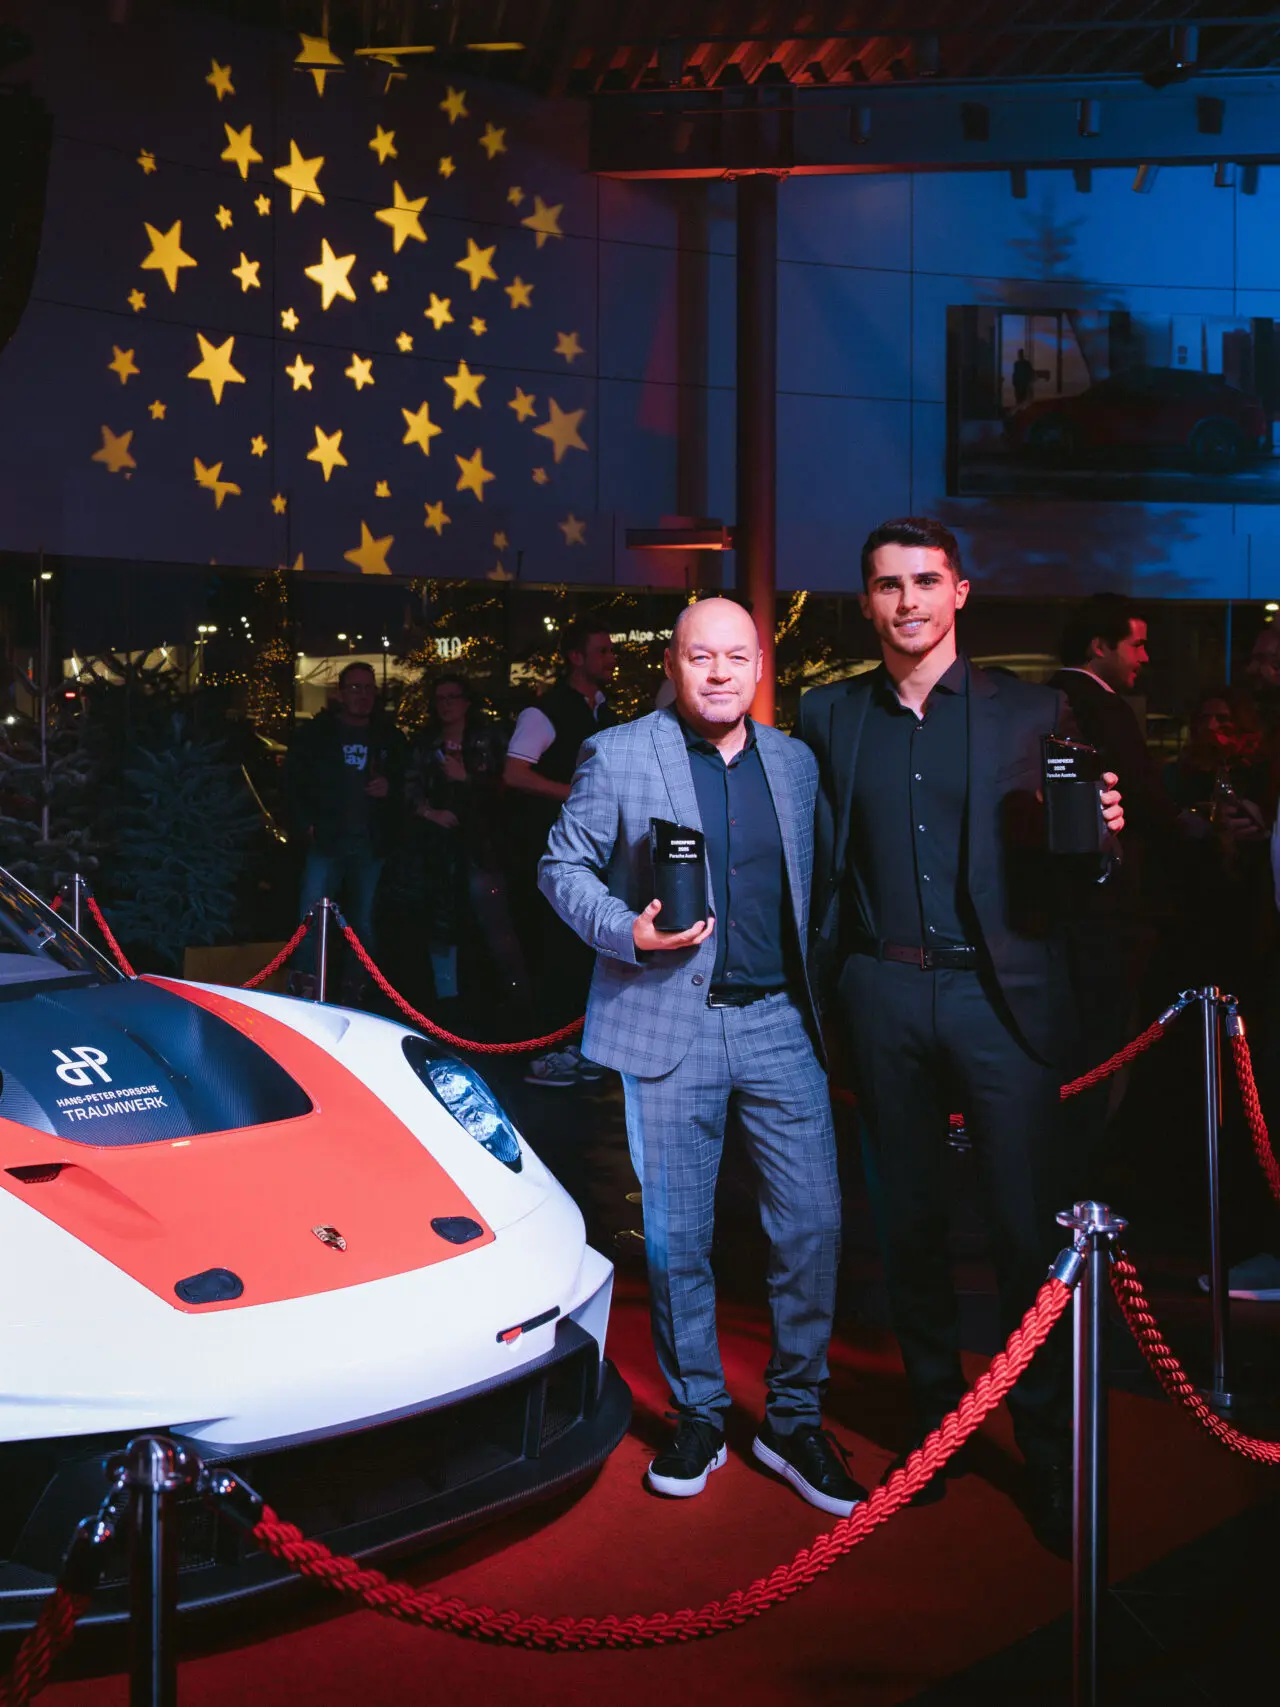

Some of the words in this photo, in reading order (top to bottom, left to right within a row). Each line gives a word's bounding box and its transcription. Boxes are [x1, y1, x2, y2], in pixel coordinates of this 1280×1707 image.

[56, 1091, 116, 1108] HANS-PETER
[117, 1085, 160, 1099] PORSCHE
[62, 1095, 169, 1122] TRAUMWERK
